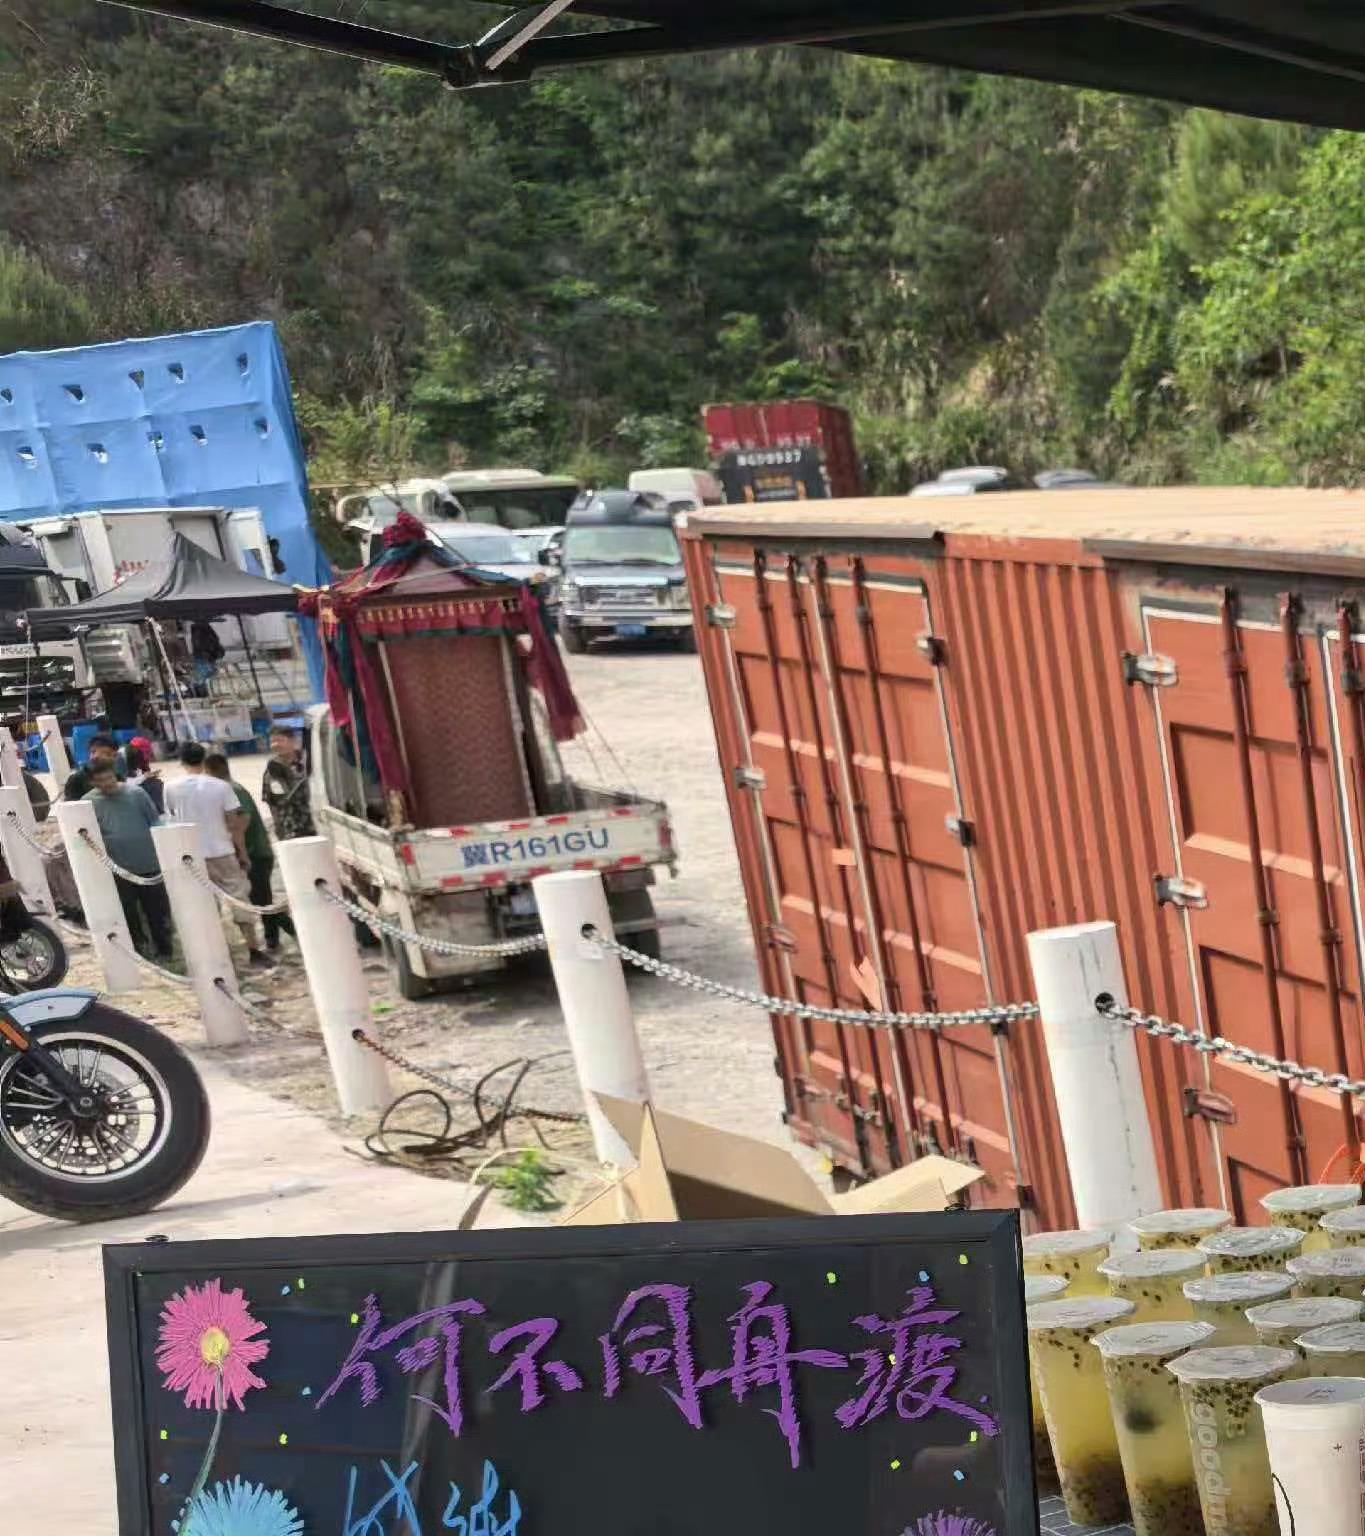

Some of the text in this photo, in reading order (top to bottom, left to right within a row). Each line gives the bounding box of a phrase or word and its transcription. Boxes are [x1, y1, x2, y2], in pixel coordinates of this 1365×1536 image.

[316, 1281, 1000, 1469] 何不同舟渡
